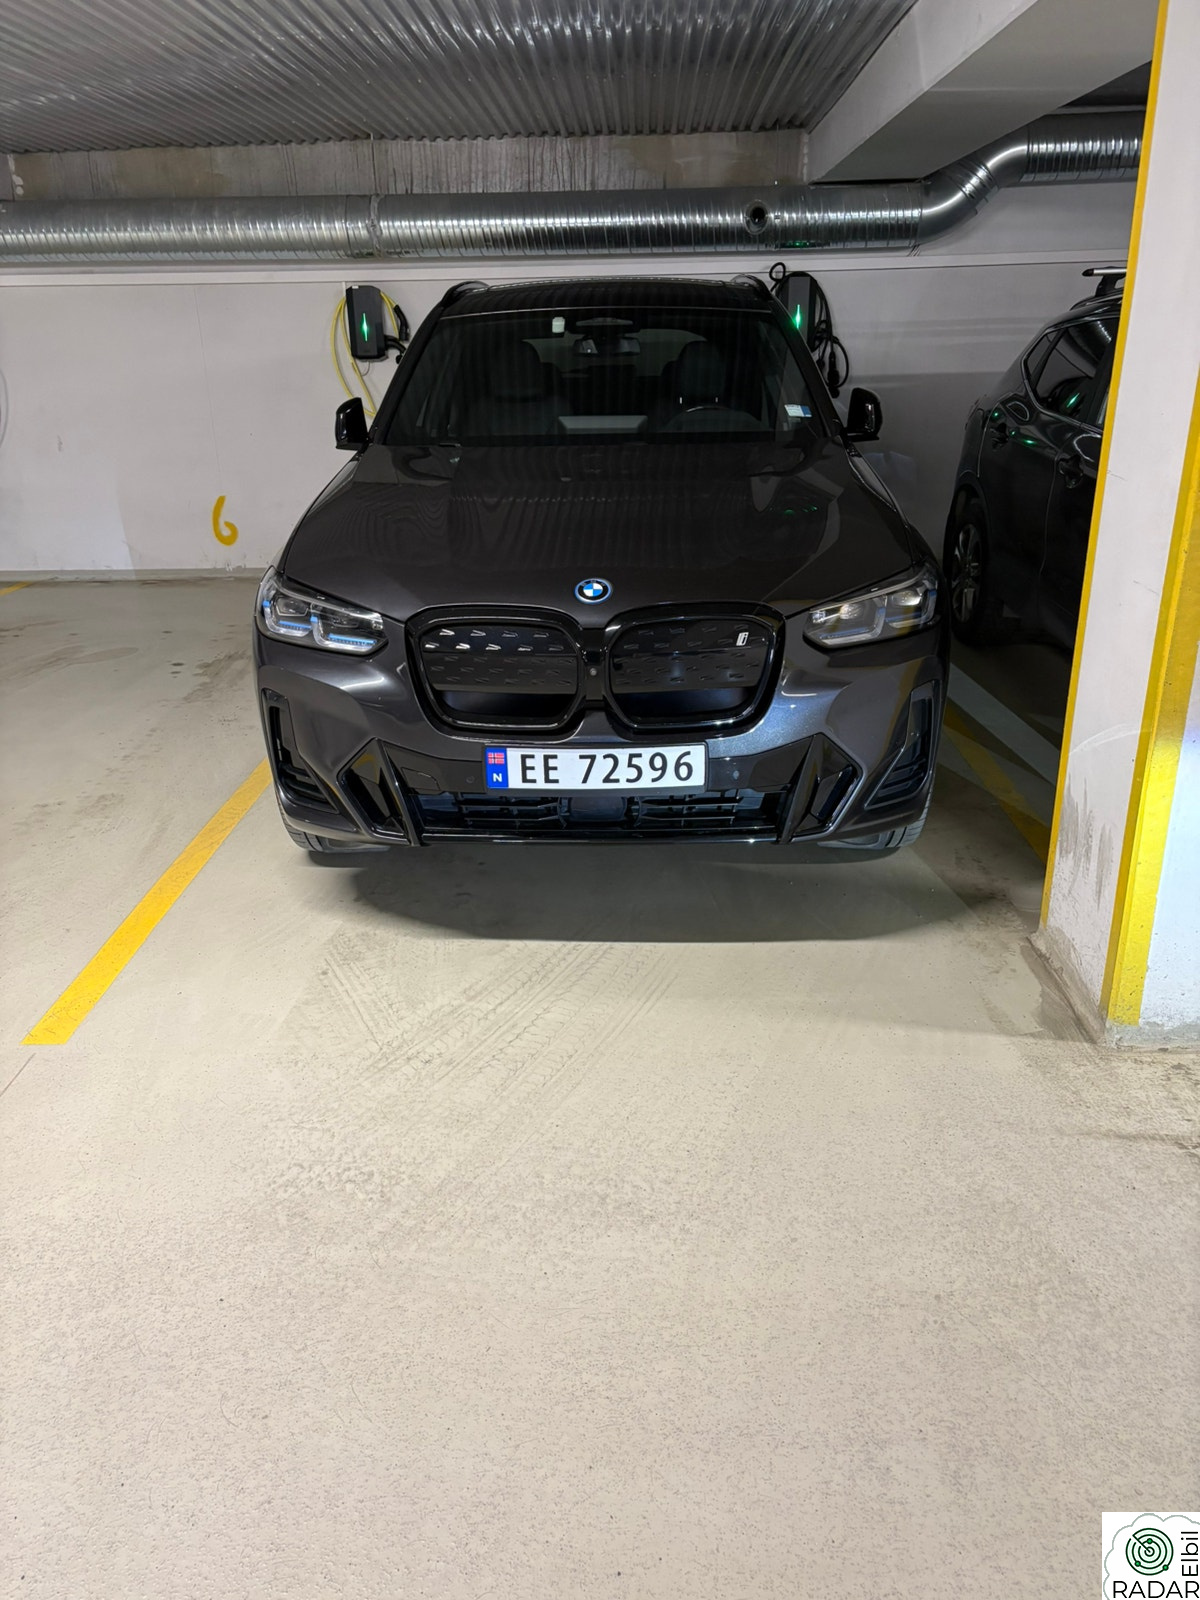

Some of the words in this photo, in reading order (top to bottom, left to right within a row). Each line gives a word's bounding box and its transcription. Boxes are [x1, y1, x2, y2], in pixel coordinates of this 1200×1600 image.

[212, 495, 239, 546] 6
[493, 773, 502, 782] N
[520, 754, 559, 784] EE
[579, 751, 694, 784] 72596
